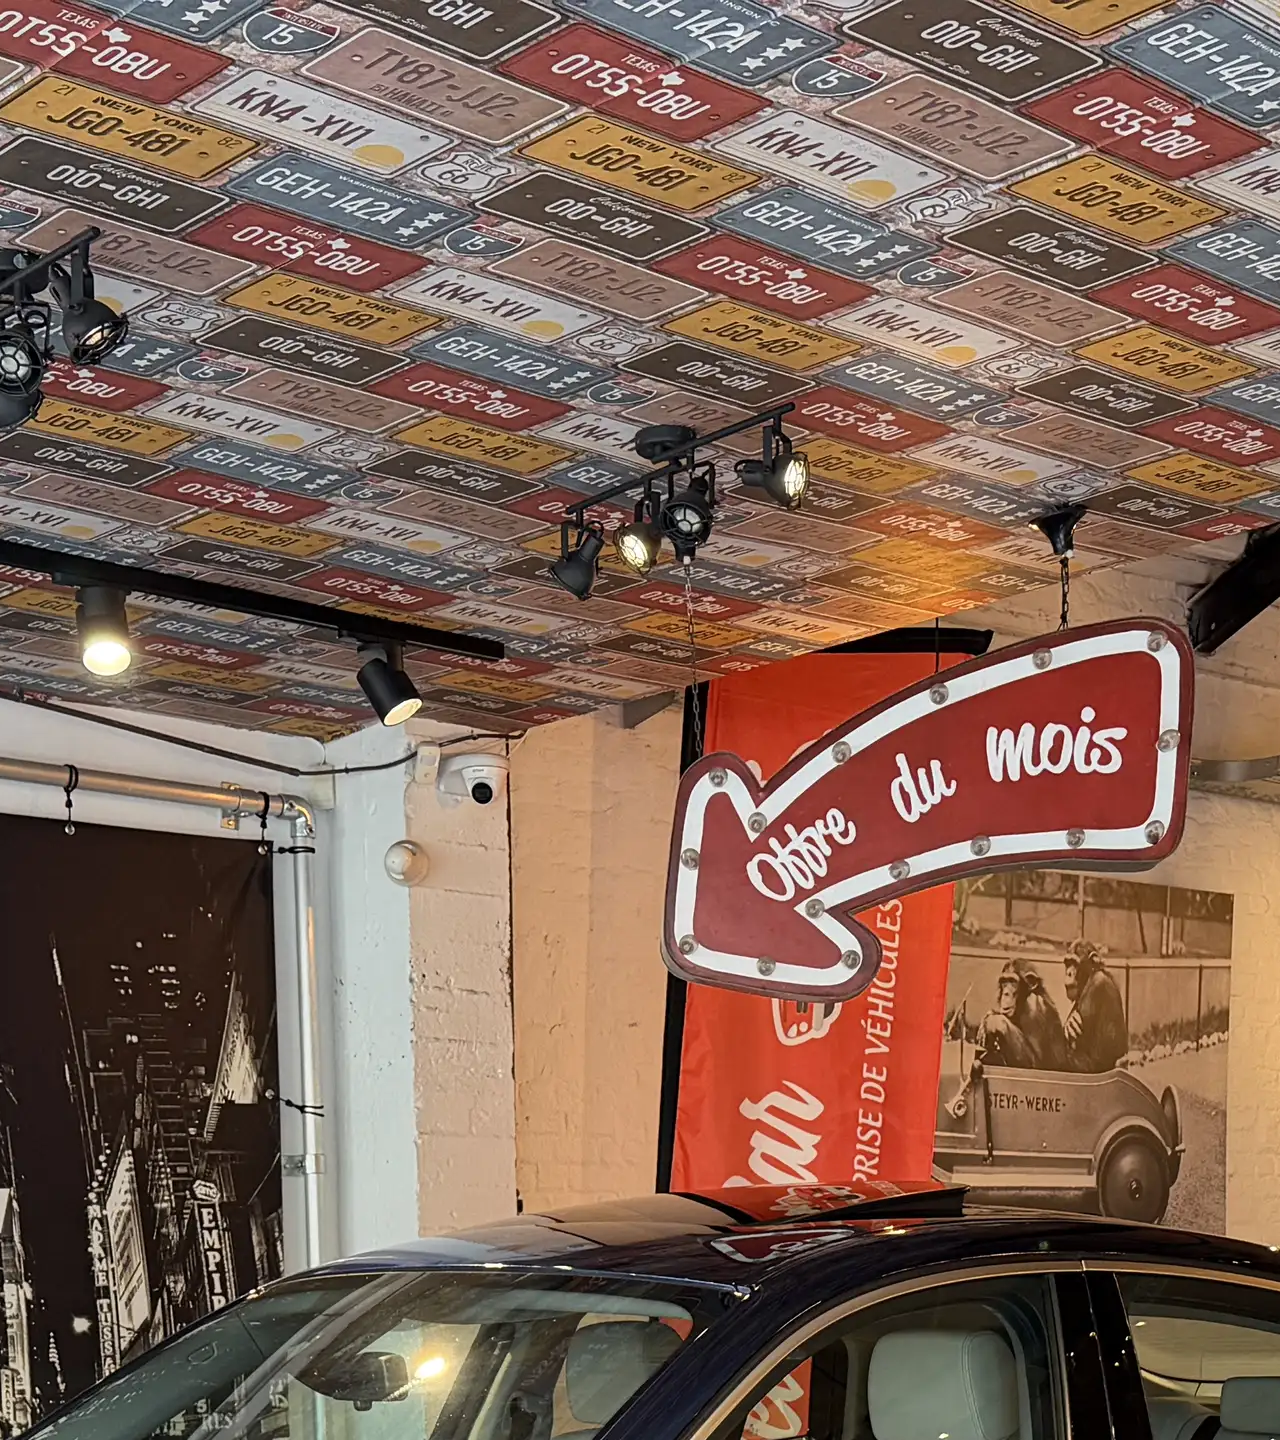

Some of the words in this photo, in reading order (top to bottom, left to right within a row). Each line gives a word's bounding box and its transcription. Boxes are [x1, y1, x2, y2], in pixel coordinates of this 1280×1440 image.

[54, 8, 101, 31] TEXAS
[261, 23, 305, 46] 15
[618, 52, 660, 73] TEXAS
[808, 68, 852, 90] 15
[91, 96, 145, 116] NEW
[151, 112, 210, 137] YORK
[1141, 95, 1179, 115] TEXAS
[619, 135, 667, 154] NEW
[668, 150, 720, 173] YORK
[427, 167, 477, 185] 66
[1108, 172, 1151, 190] NEW
[1148, 187, 1194, 209] YORK
[255, 168, 407, 225] GEH-142A
[743, 202, 877, 256] GEH-142A
[435, 338, 560, 380] GEH-142A
[846, 363, 958, 403] GEH-142A
[194, 448, 310, 482] GEH-142A
[889, 751, 957, 825] du
[985, 705, 1128, 783] mois
[860, 898, 904, 1055] VÉHICULES
[860, 1062, 888, 1105] DE
